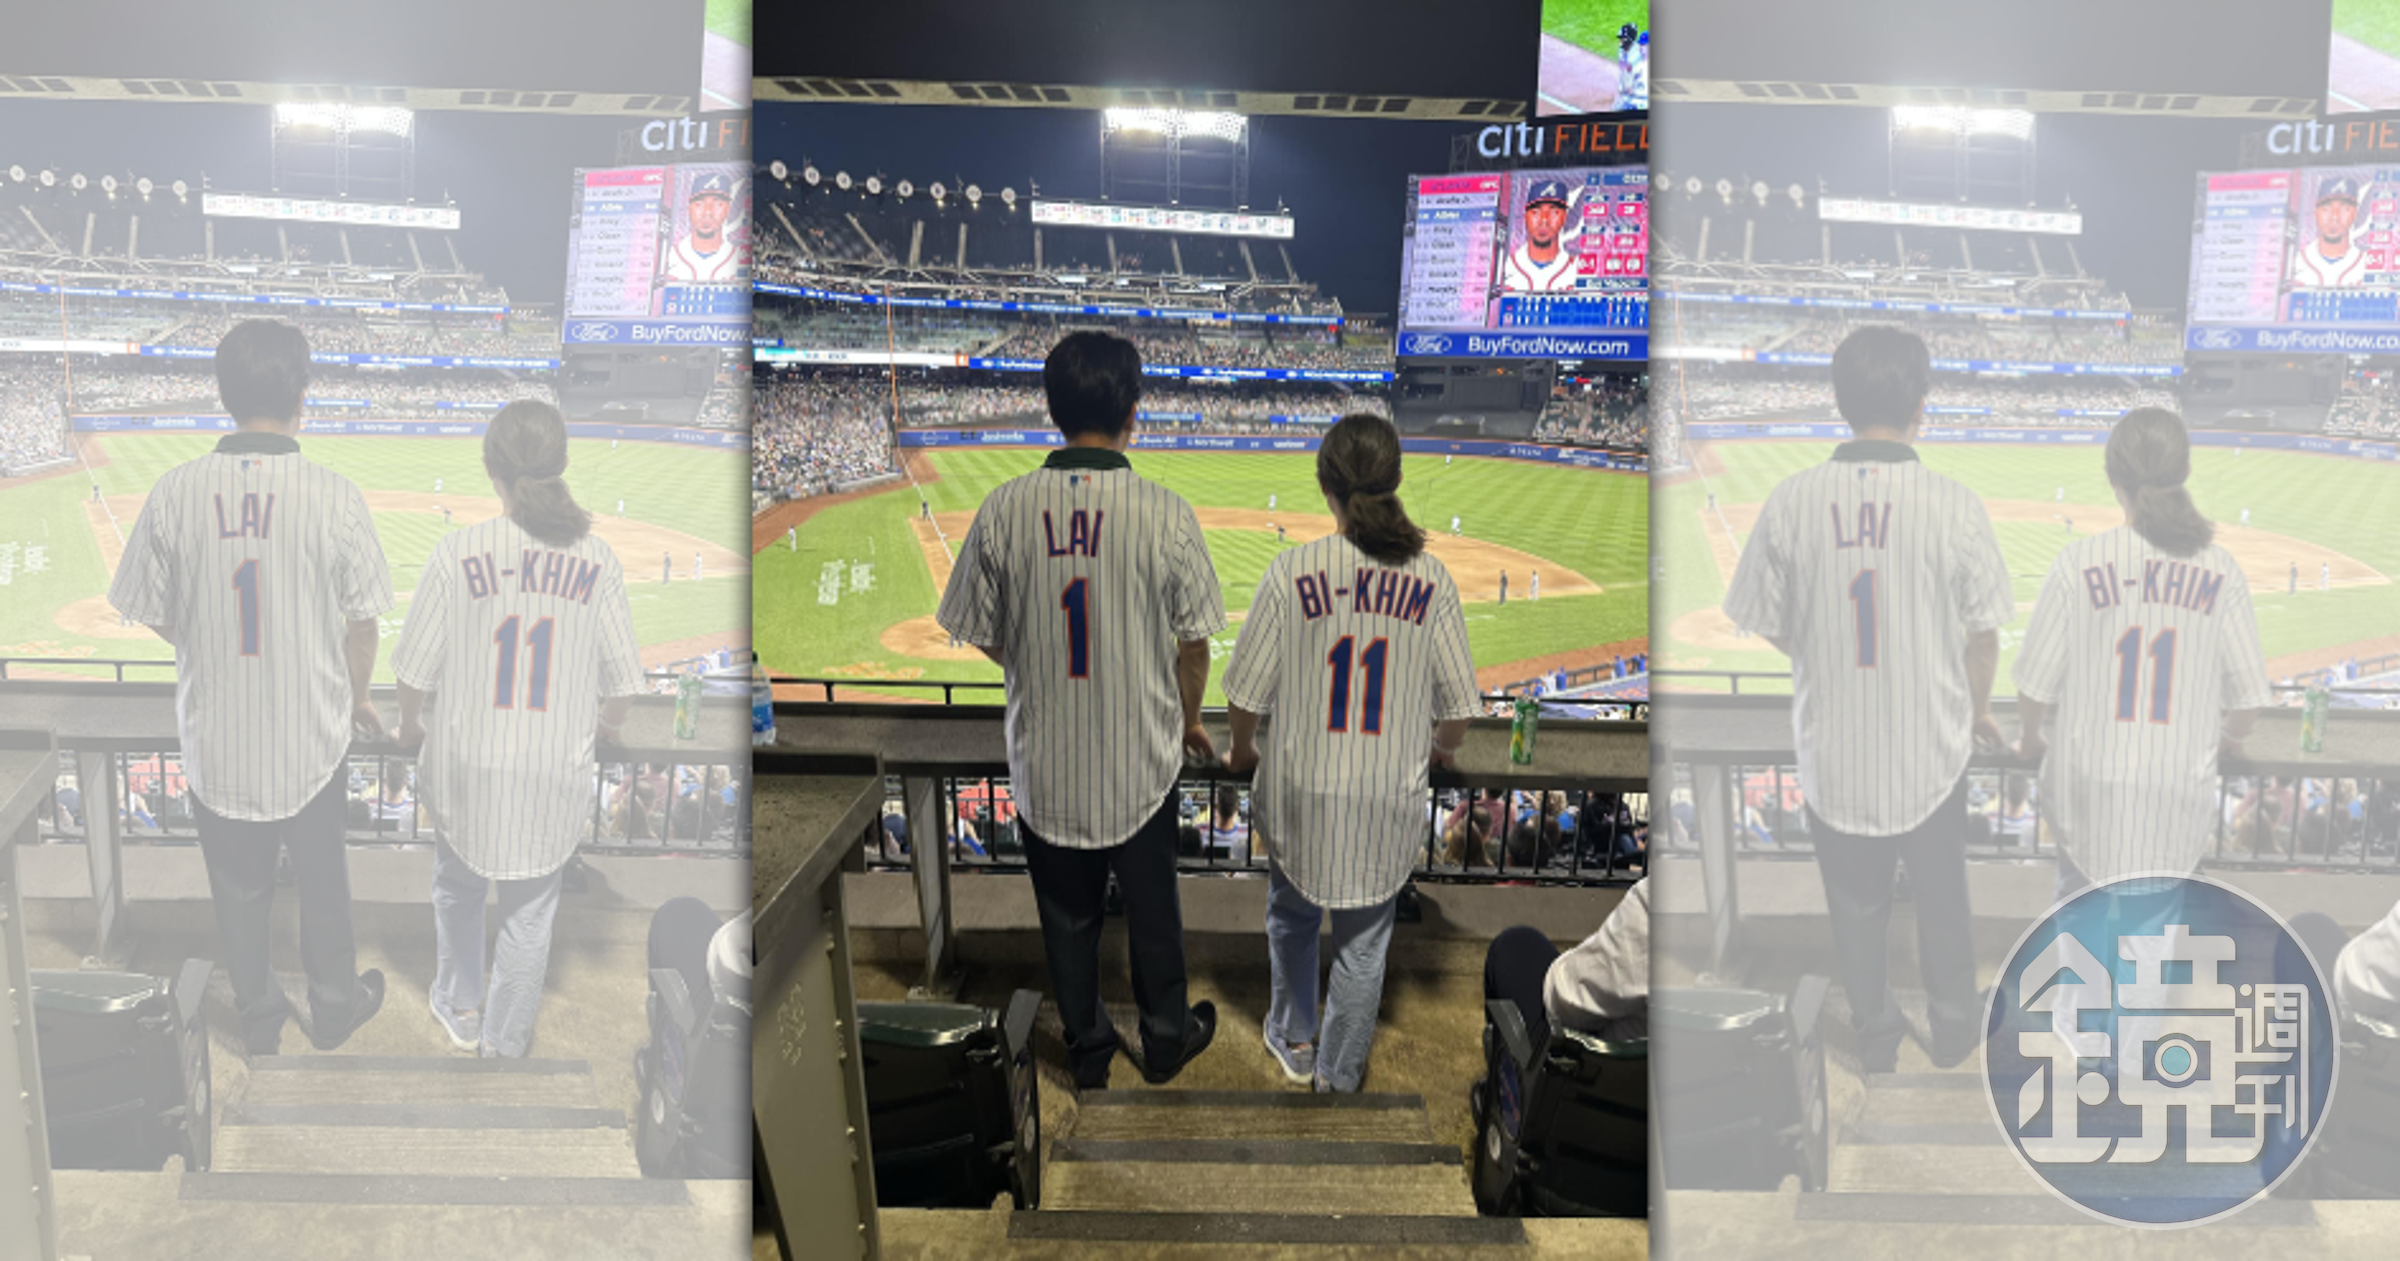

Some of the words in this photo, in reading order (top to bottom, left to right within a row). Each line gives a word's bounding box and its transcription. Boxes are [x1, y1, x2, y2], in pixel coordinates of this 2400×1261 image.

[1467, 335, 1629, 356] BuyFordNow.com
[214, 493, 275, 539] LAI
[1043, 509, 1104, 557] LAI
[1831, 502, 1892, 549] LAI
[460, 549, 603, 605] BI-KHIM
[1295, 566, 1436, 626] BI-KHIM
[2082, 559, 2226, 616] BI-KHIM
[231, 558, 260, 657] 1
[1060, 576, 1089, 679] 1
[1848, 568, 1877, 669] 1
[493, 614, 555, 712] 11
[1327, 635, 1389, 736] 11
[2115, 625, 2177, 725] 11
